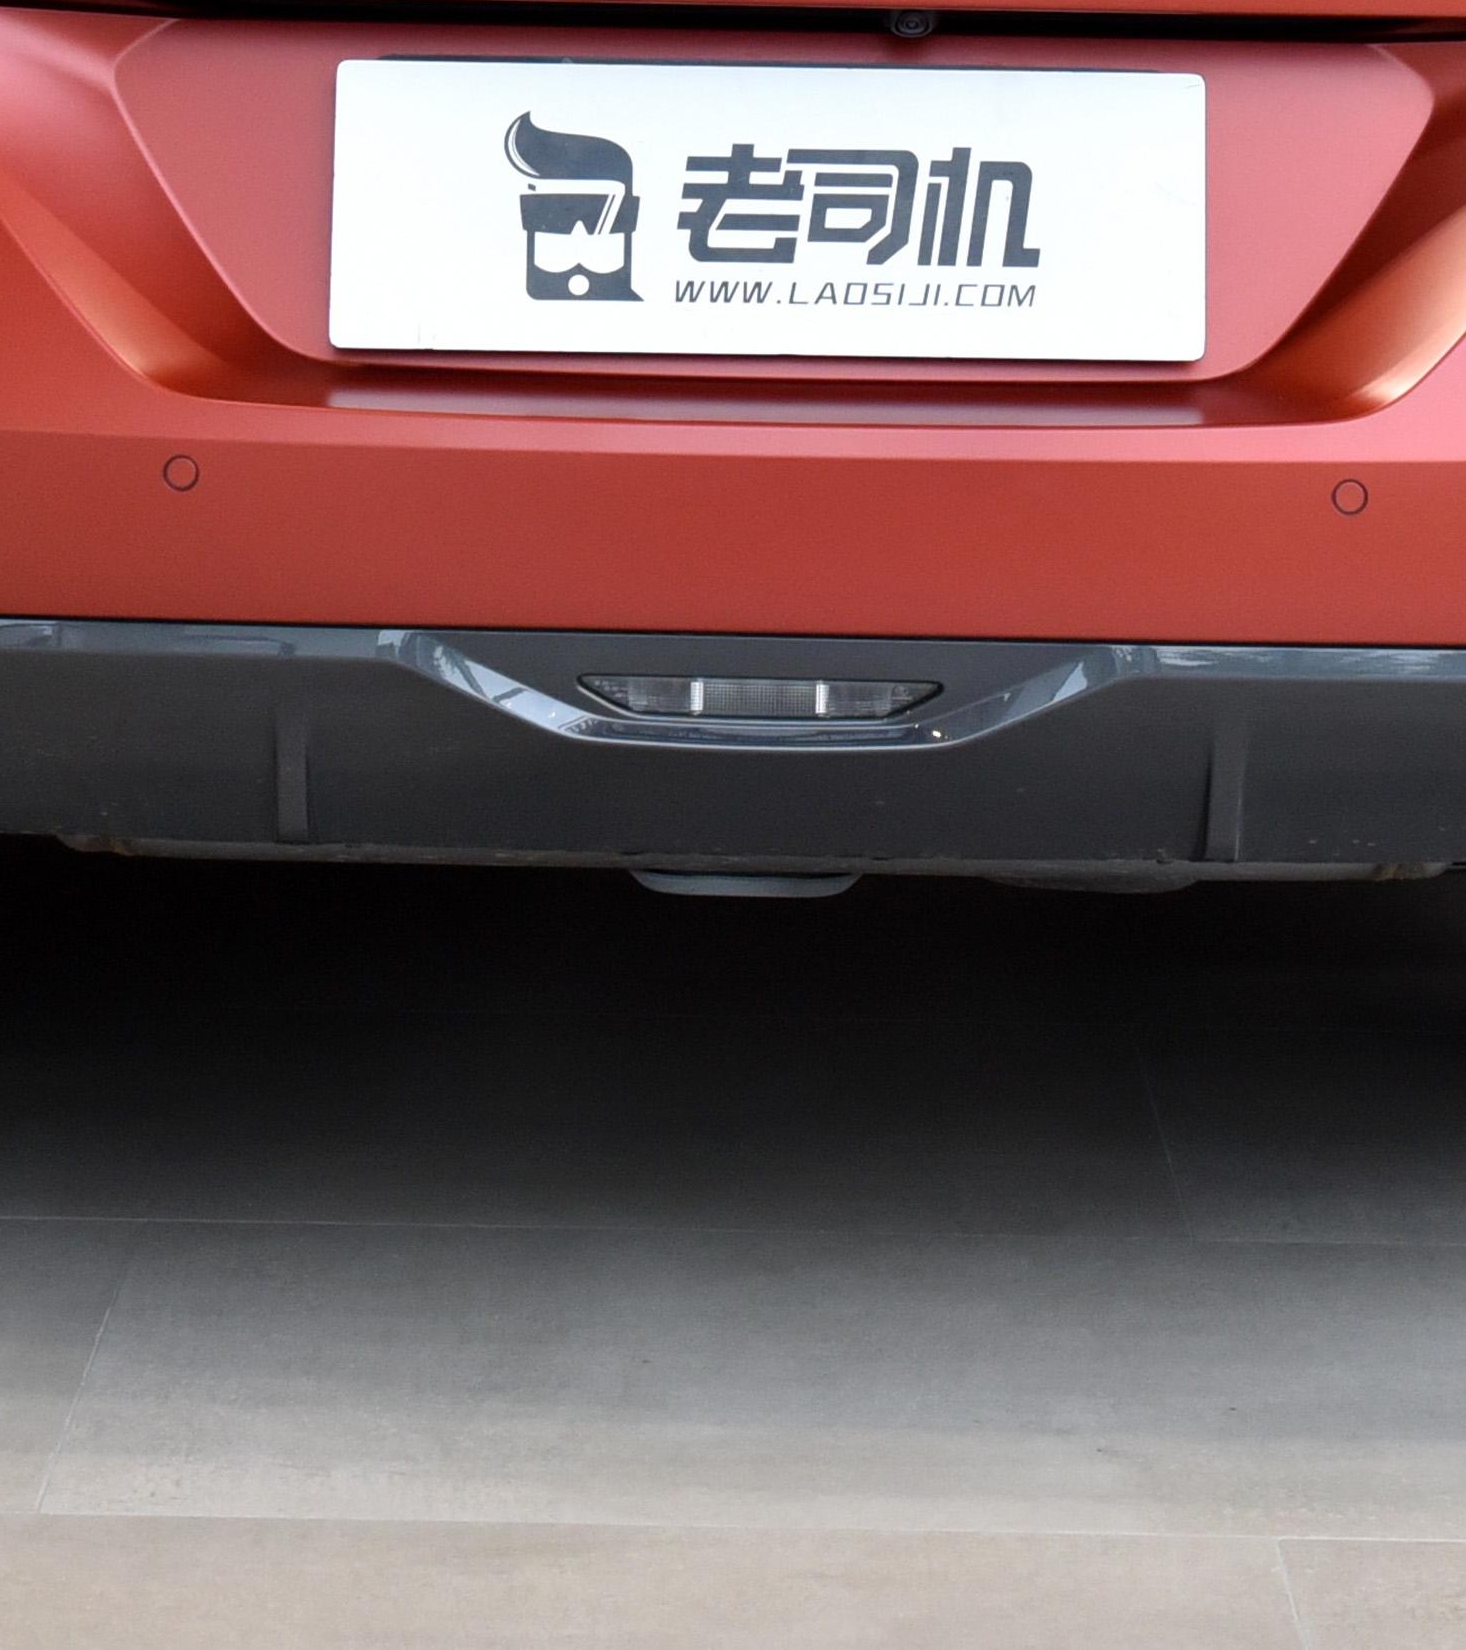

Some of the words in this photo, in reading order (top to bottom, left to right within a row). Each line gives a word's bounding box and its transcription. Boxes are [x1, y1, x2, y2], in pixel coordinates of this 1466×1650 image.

[677, 143, 1041, 267] 老司机
[675, 280, 1036, 307] WWW.LAOSIJI.COM
